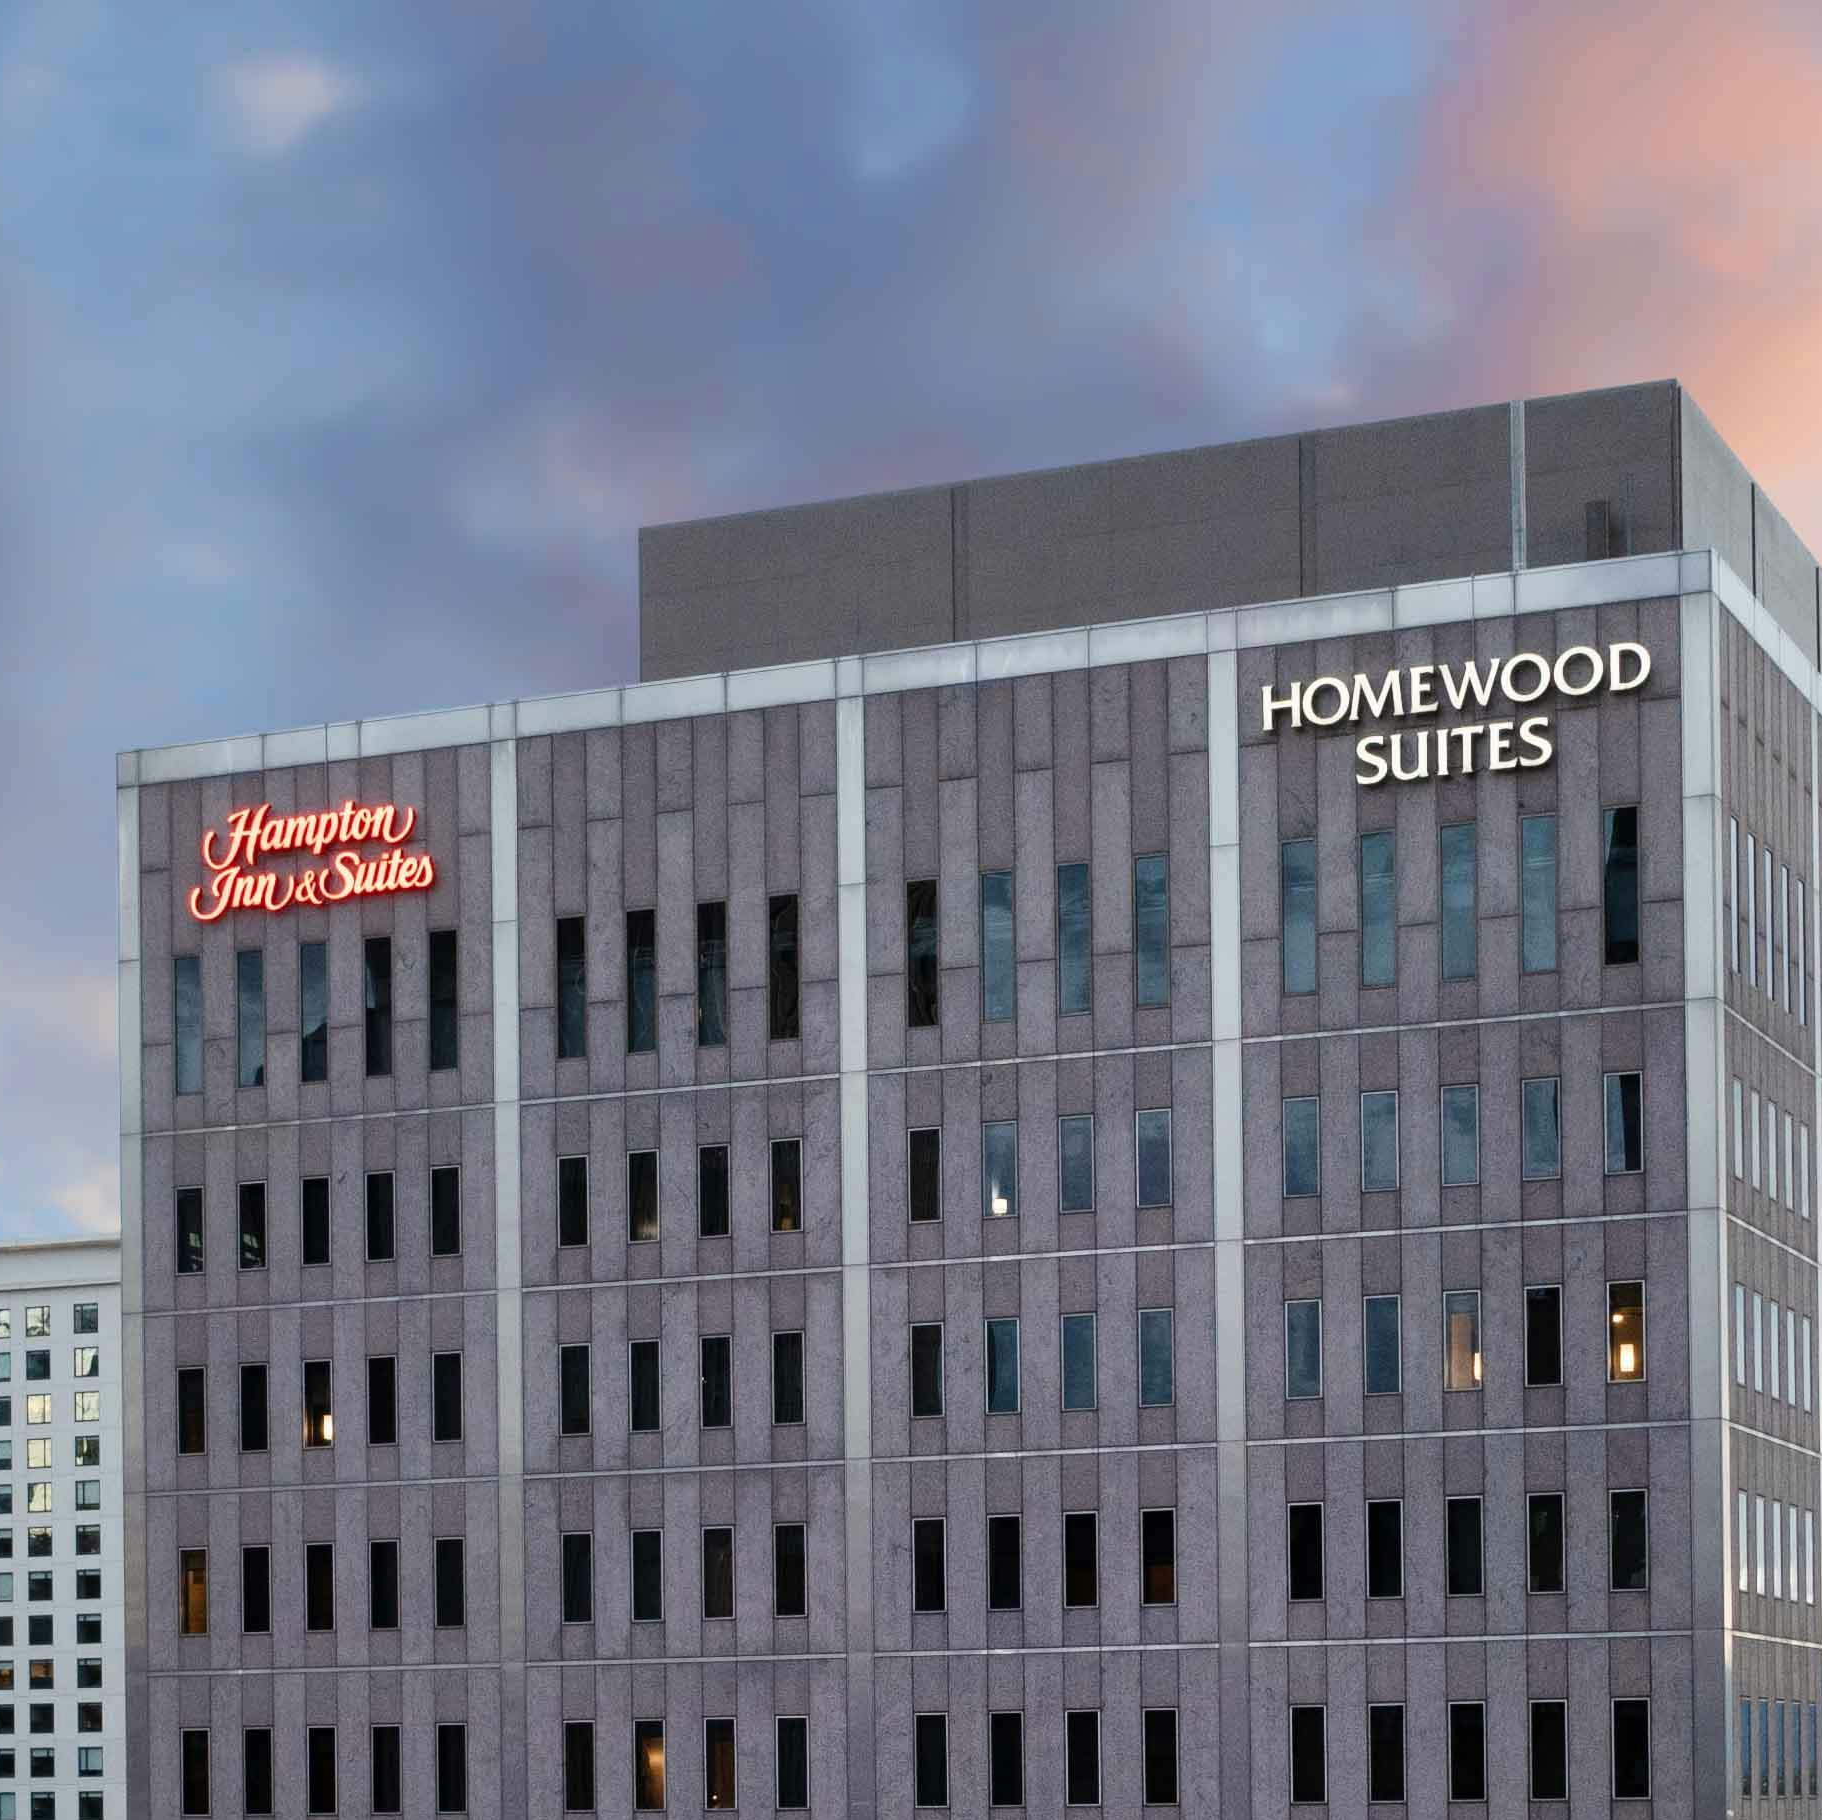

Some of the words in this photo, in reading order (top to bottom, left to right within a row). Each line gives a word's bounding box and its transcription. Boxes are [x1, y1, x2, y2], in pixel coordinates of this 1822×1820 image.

[1261, 641, 1651, 731] HOMEWOOD
[1355, 715, 1554, 786] SUITES
[203, 800, 415, 871] Hampton
[189, 865, 293, 920] Inn
[294, 869, 323, 905] &
[319, 849, 434, 900] Suites
